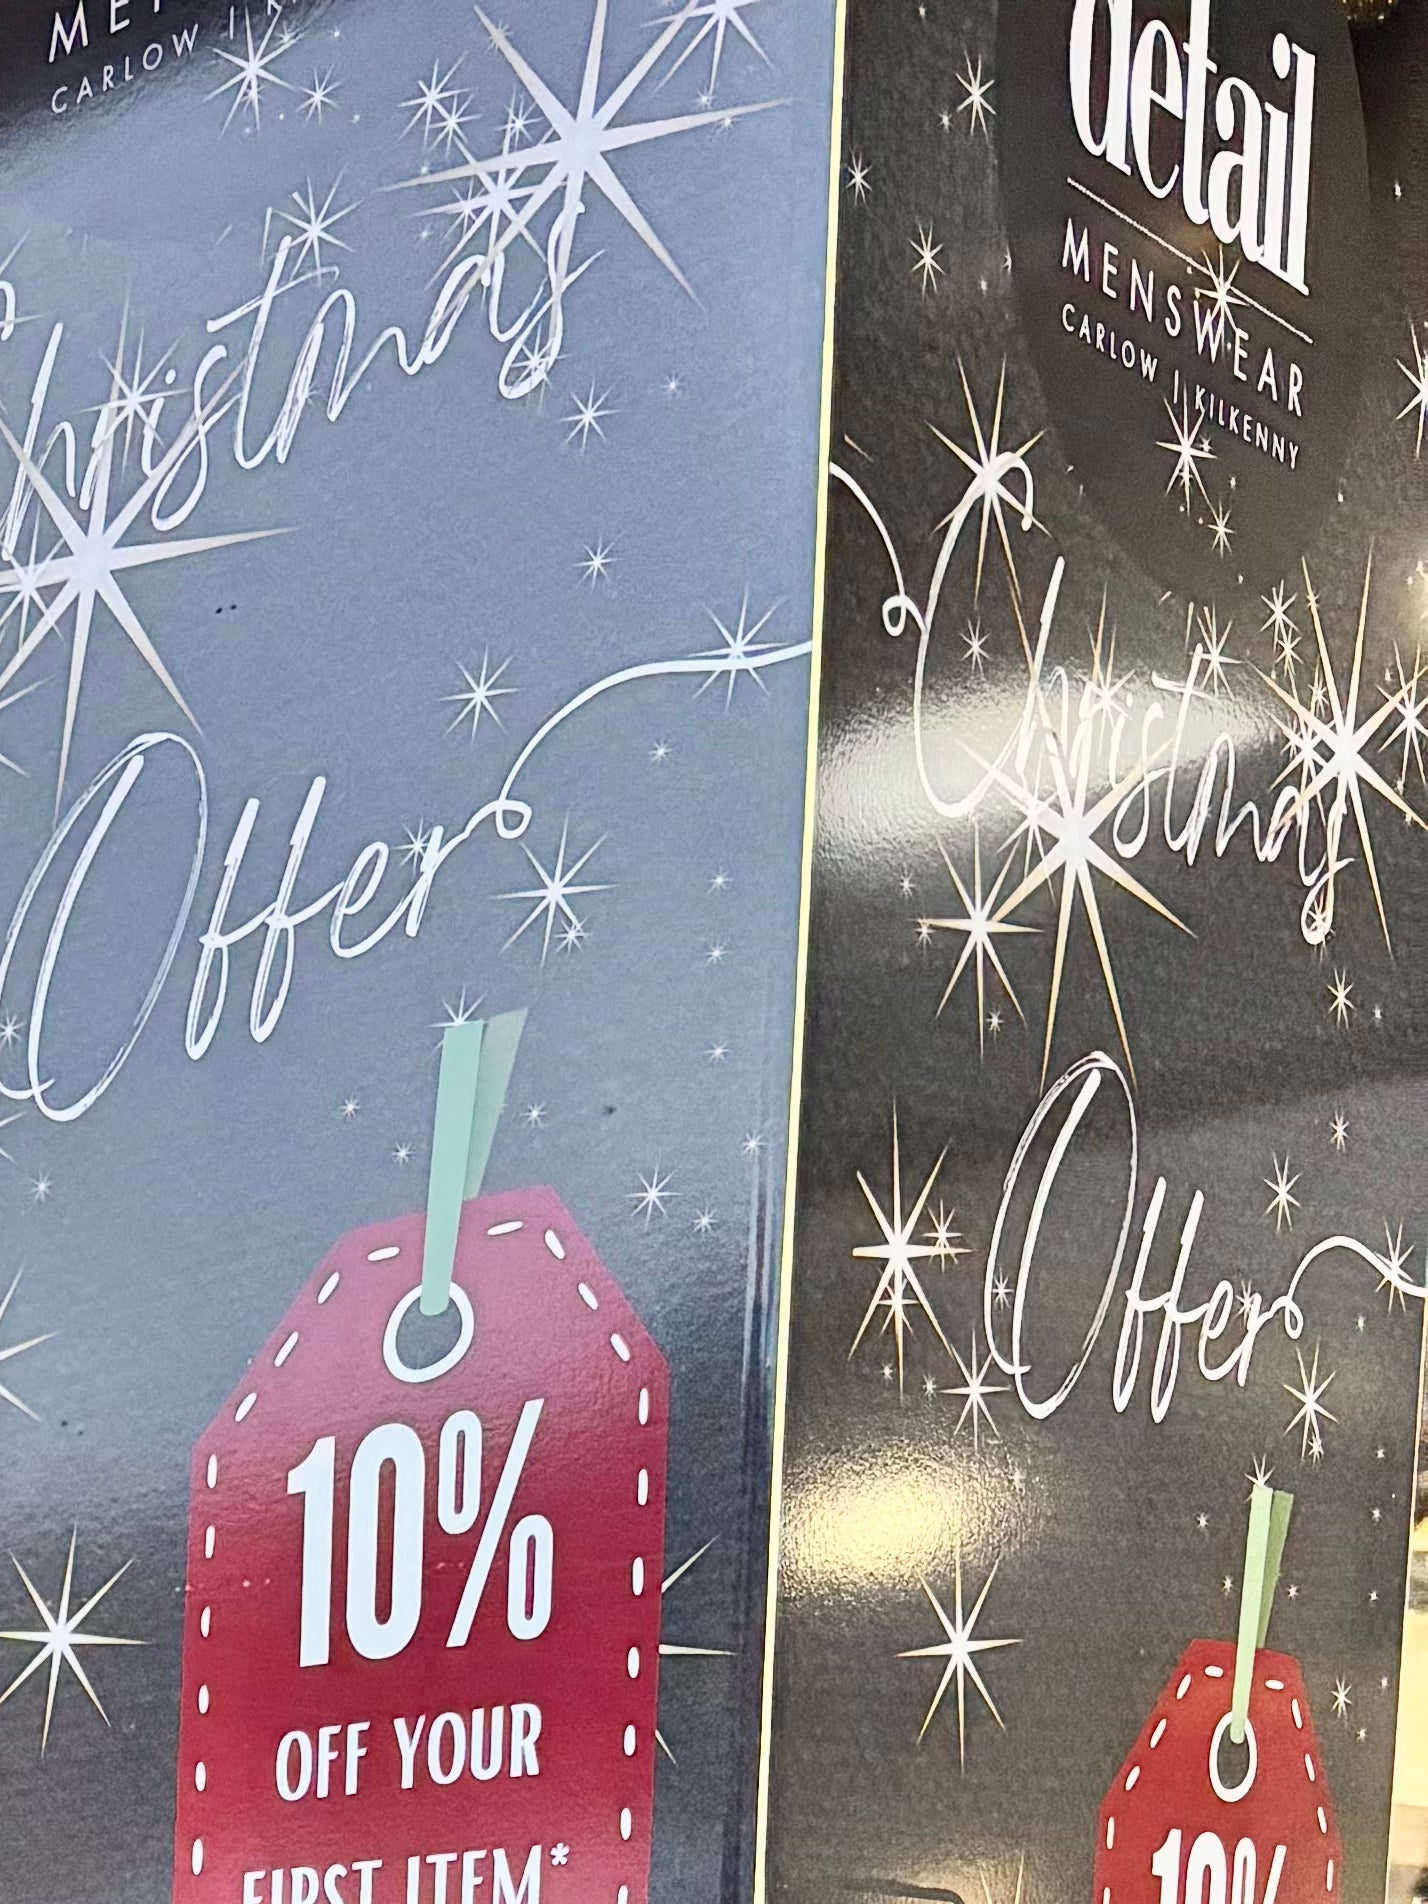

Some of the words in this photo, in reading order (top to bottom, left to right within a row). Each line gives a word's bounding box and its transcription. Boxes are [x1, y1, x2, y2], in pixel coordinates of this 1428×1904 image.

[48, 0, 161, 63] ME
[51, 24, 198, 113] CARLOW
[1069, 0, 1315, 295] detail
[1062, 218, 1303, 415] MENSWEAR
[1062, 303, 1157, 382] CARLOW
[1195, 384, 1300, 468] KILKENNY
[882, 452, 1354, 945] Christmas
[984, 1051, 1302, 1423] Offer
[286, 1398, 553, 1667] 10%
[276, 1721, 370, 1801] OFF
[393, 1703, 542, 1790] YOUR
